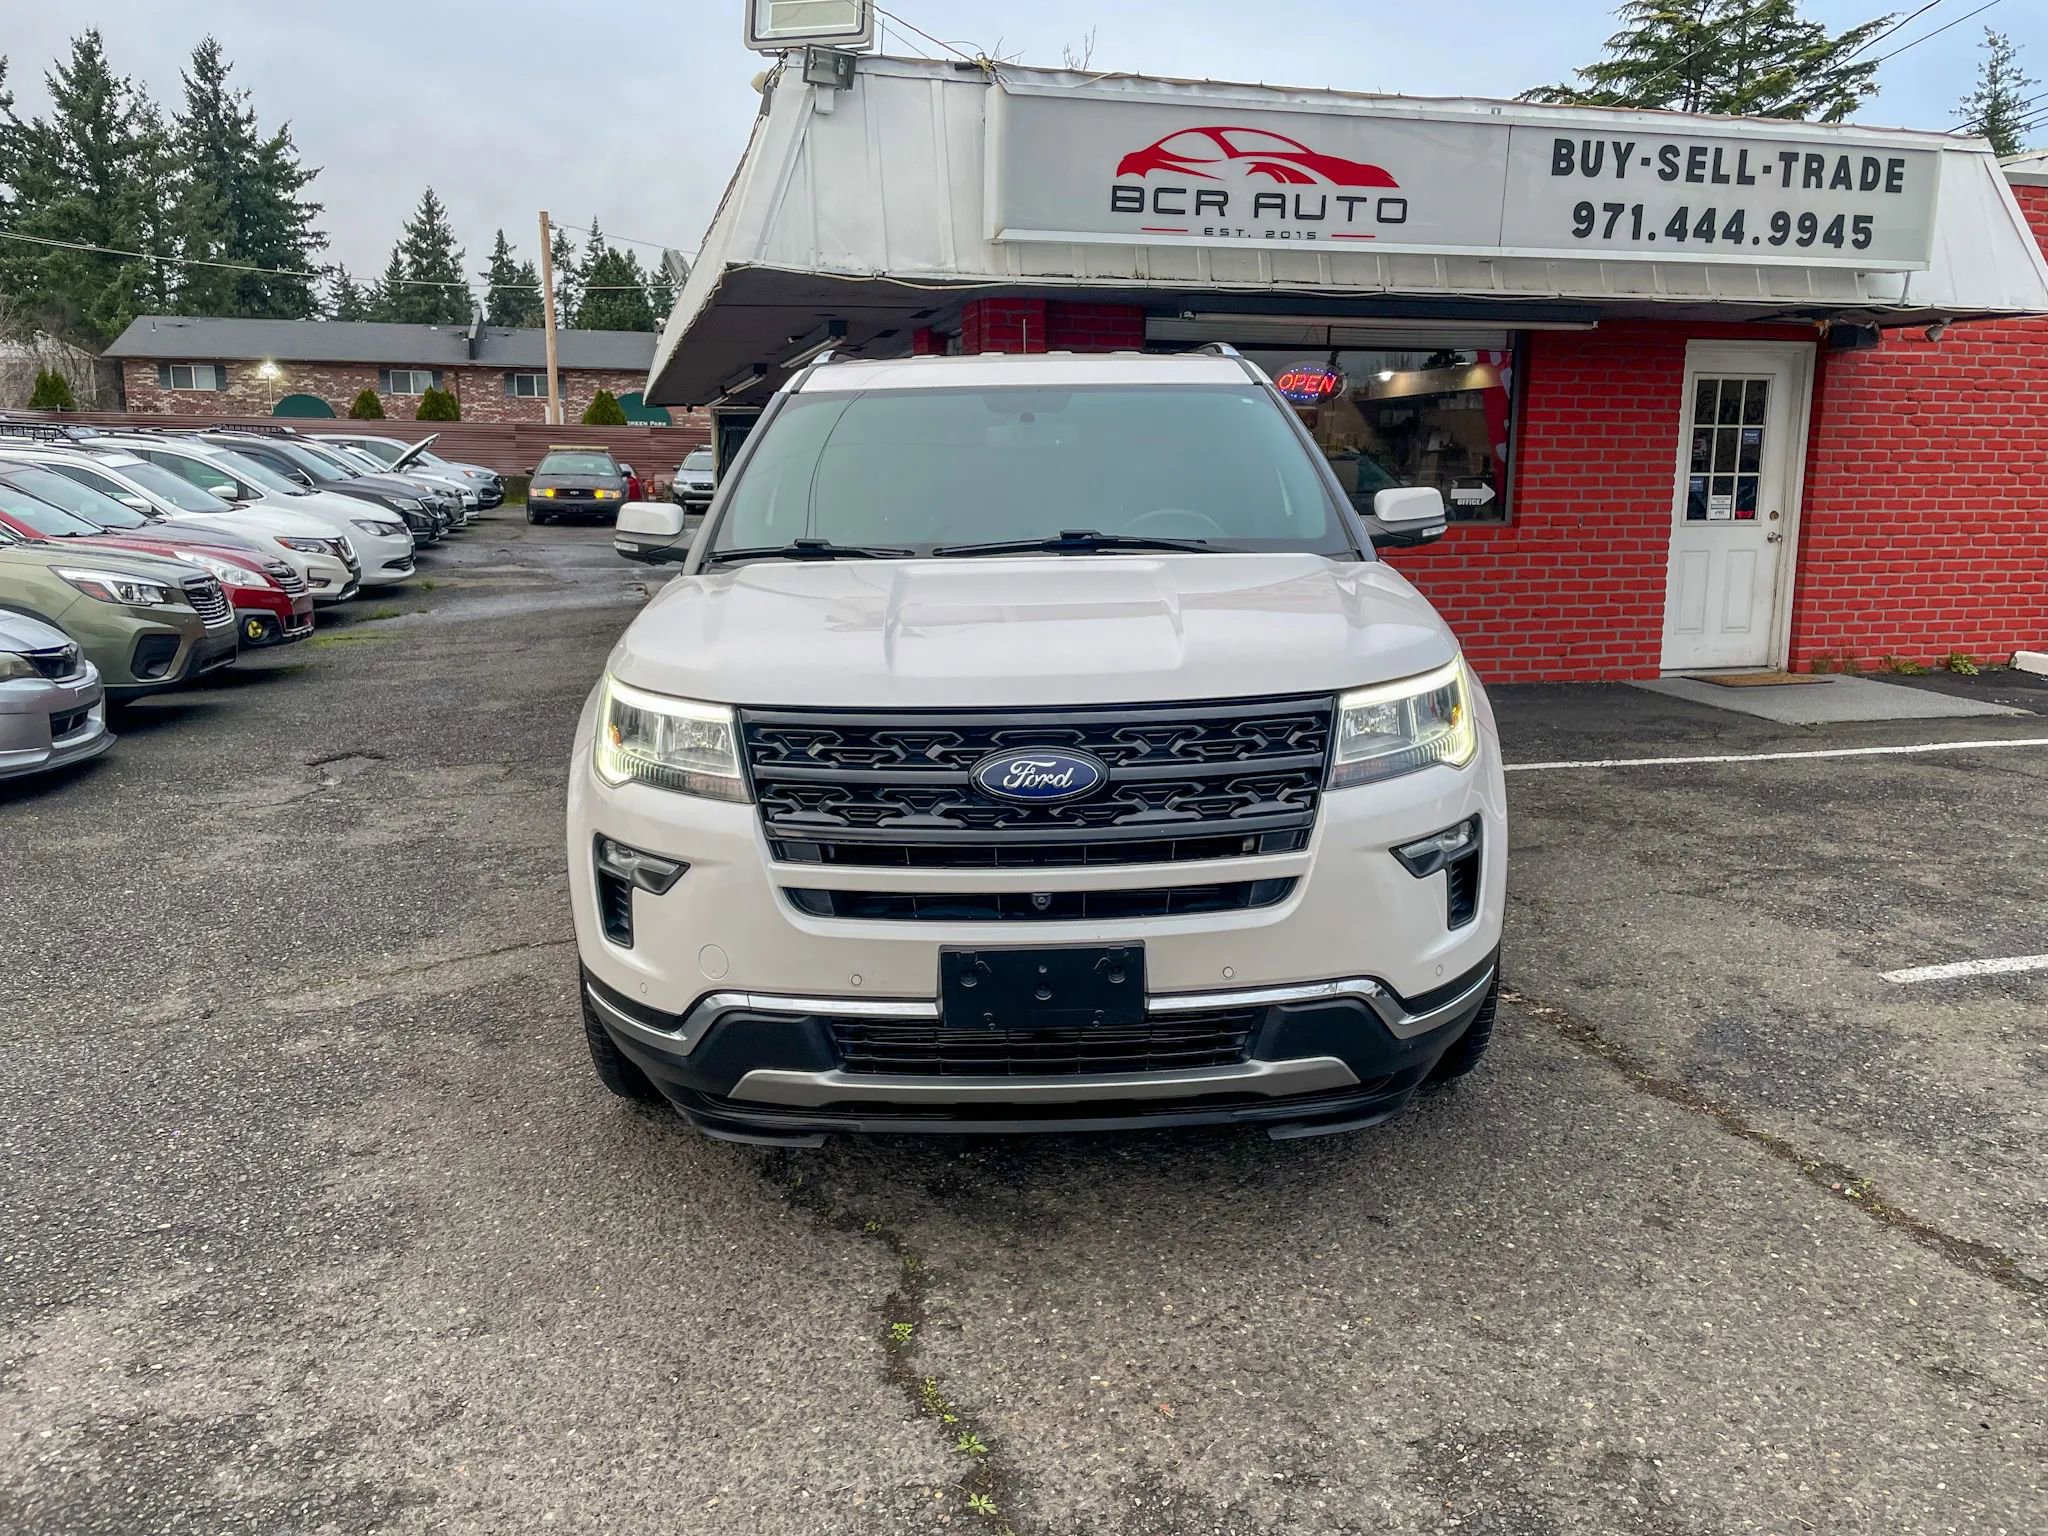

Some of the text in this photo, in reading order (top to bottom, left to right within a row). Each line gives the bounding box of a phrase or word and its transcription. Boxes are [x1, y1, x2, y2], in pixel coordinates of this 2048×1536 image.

[1551, 138, 1906, 194] BUY-SELL-TRADE
[1111, 185, 1408, 224] BCR AUTO
[1203, 227, 1317, 240] EST. 2015
[1572, 201, 1875, 250] 971.444.9945
[1279, 373, 1338, 393] OPEN
[1002, 760, 1074, 789] Ford
